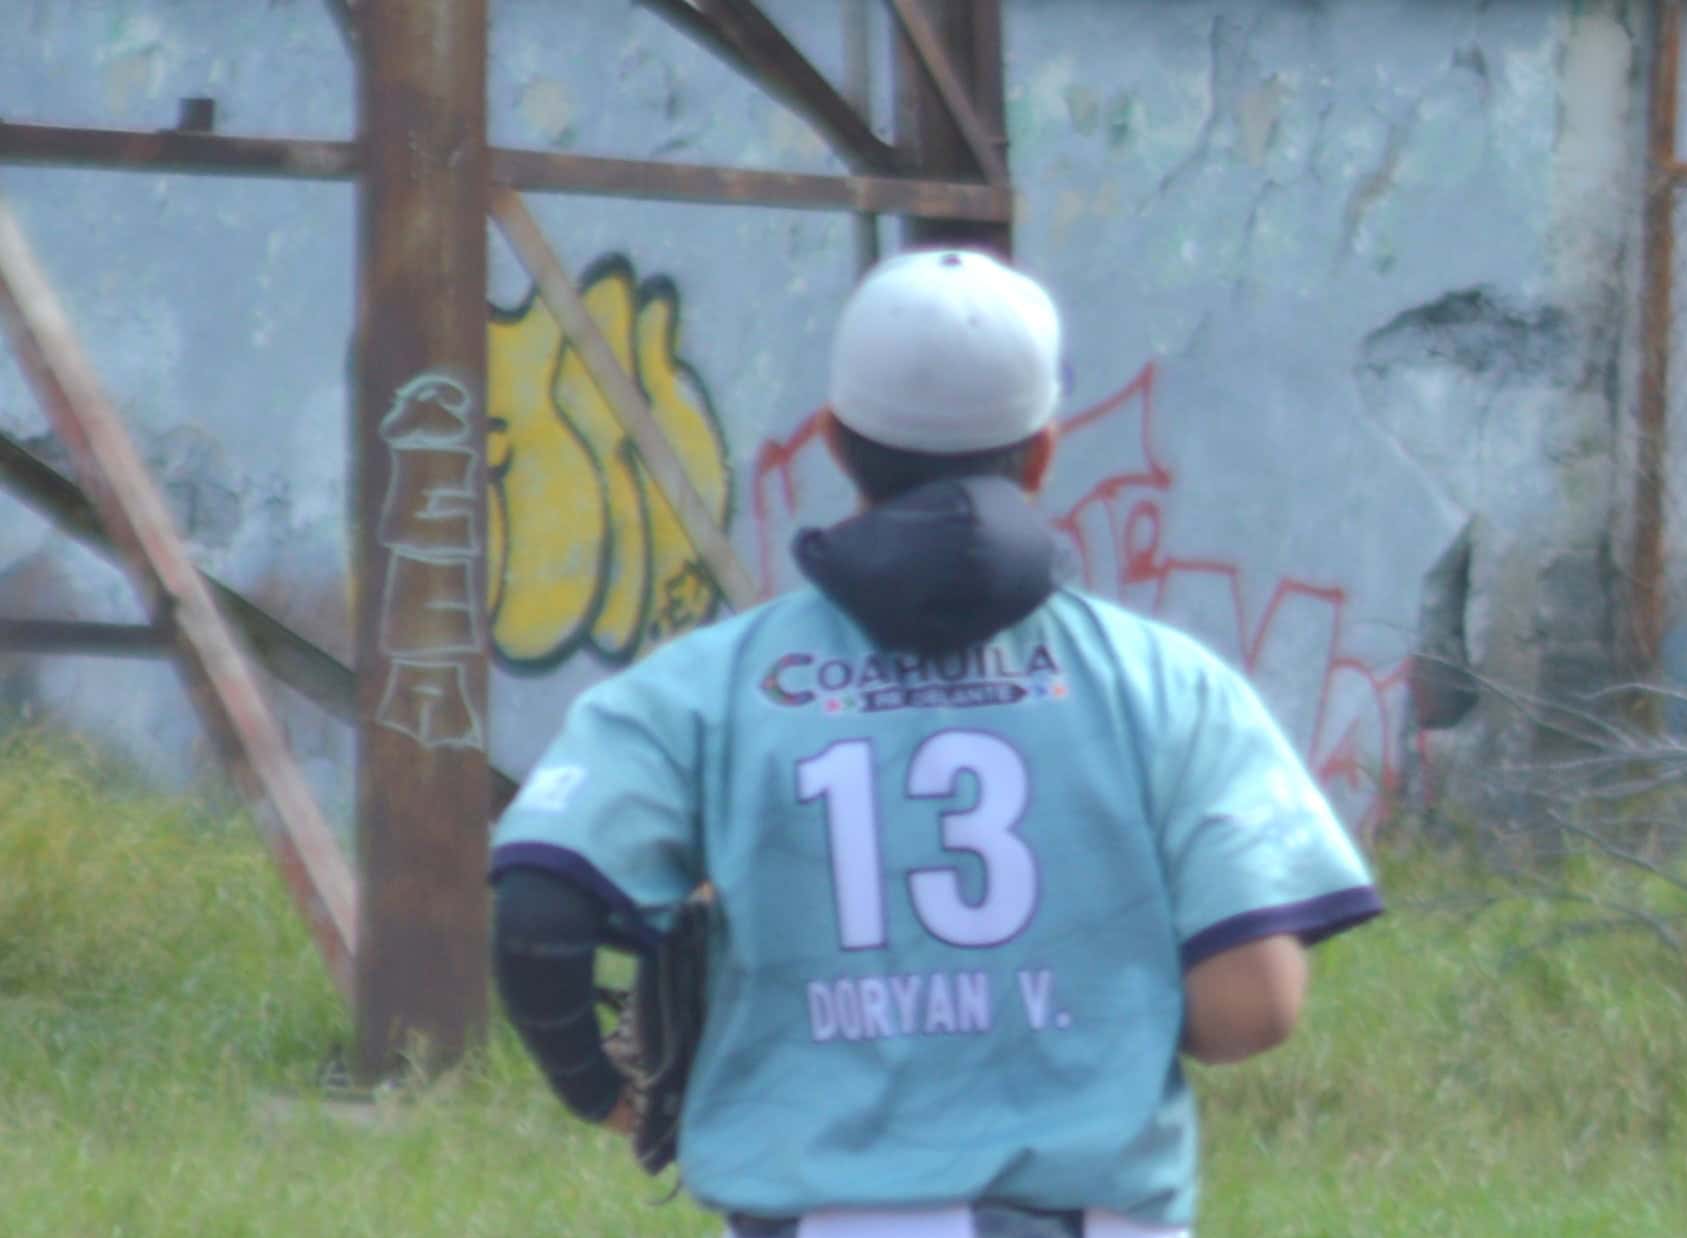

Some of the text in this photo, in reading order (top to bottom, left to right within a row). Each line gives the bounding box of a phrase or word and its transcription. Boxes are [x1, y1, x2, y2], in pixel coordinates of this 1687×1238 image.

[761, 643, 1060, 707] COAHUILA
[795, 727, 1040, 951] 13
[806, 969, 1072, 1043] DORYAN V.
